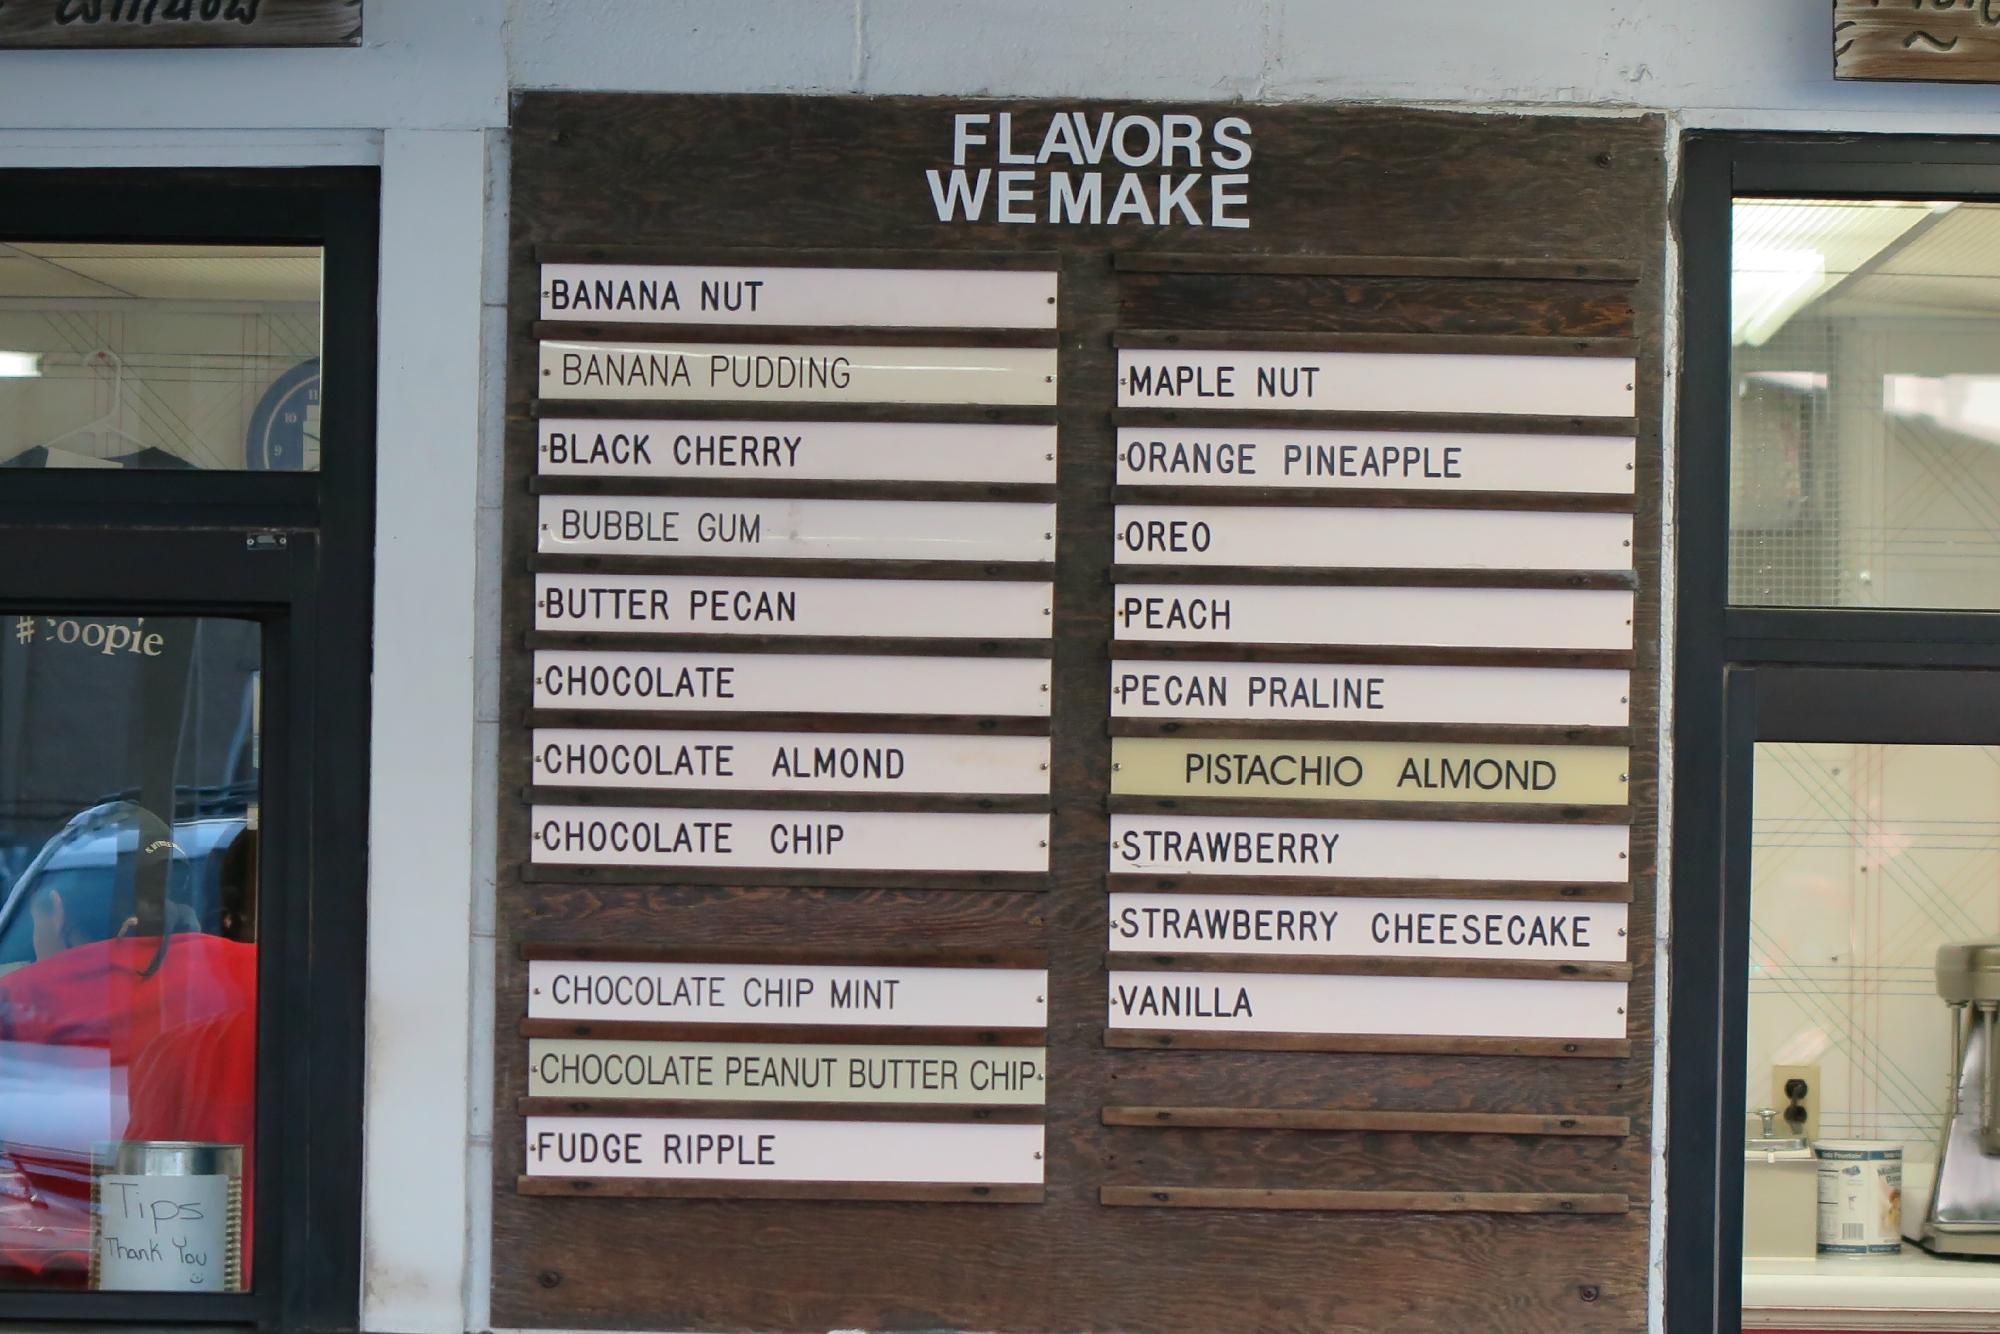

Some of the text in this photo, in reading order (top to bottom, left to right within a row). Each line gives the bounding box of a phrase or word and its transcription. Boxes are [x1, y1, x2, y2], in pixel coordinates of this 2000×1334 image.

[954, 112, 1251, 169] FLAVORS
[552, 280, 763, 311] BANANA NUT
[564, 354, 849, 388] BANANA PUDDING
[1130, 366, 1320, 397] MAPLE NUT
[550, 433, 801, 466] BLACK CHERRY
[1127, 442, 1461, 478] ORANGE PINEAPPLE
[563, 509, 759, 543] BUBBLE GUM
[1125, 521, 1210, 552] OREO
[547, 588, 795, 621] BUTTER PECAN
[1125, 598, 1230, 629] PEACH
[545, 665, 734, 698] CHOCOLATE
[1122, 675, 1384, 709] PECAN PRALINE
[544, 744, 903, 779] CHOCOLATE ALMOND
[1187, 754, 1555, 790] PISTACHIO ALMOND
[543, 821, 843, 854] CHOCOLATE CHIP
[1122, 831, 1339, 863] STRAWBERRY
[1120, 908, 1590, 947] STRAWBERRY CHEESECAKE
[553, 975, 899, 1009] CHOCOLATE CHIP MINT
[1119, 985, 1252, 1017] VANILLA
[541, 1053, 1035, 1090] CHOCOLATE PEANUT BUTTER CHIP
[539, 1132, 775, 1165] FUDGE RIPPLE
[109, 1182, 205, 1234] Tips
[104, 1236, 208, 1267] Thank You
